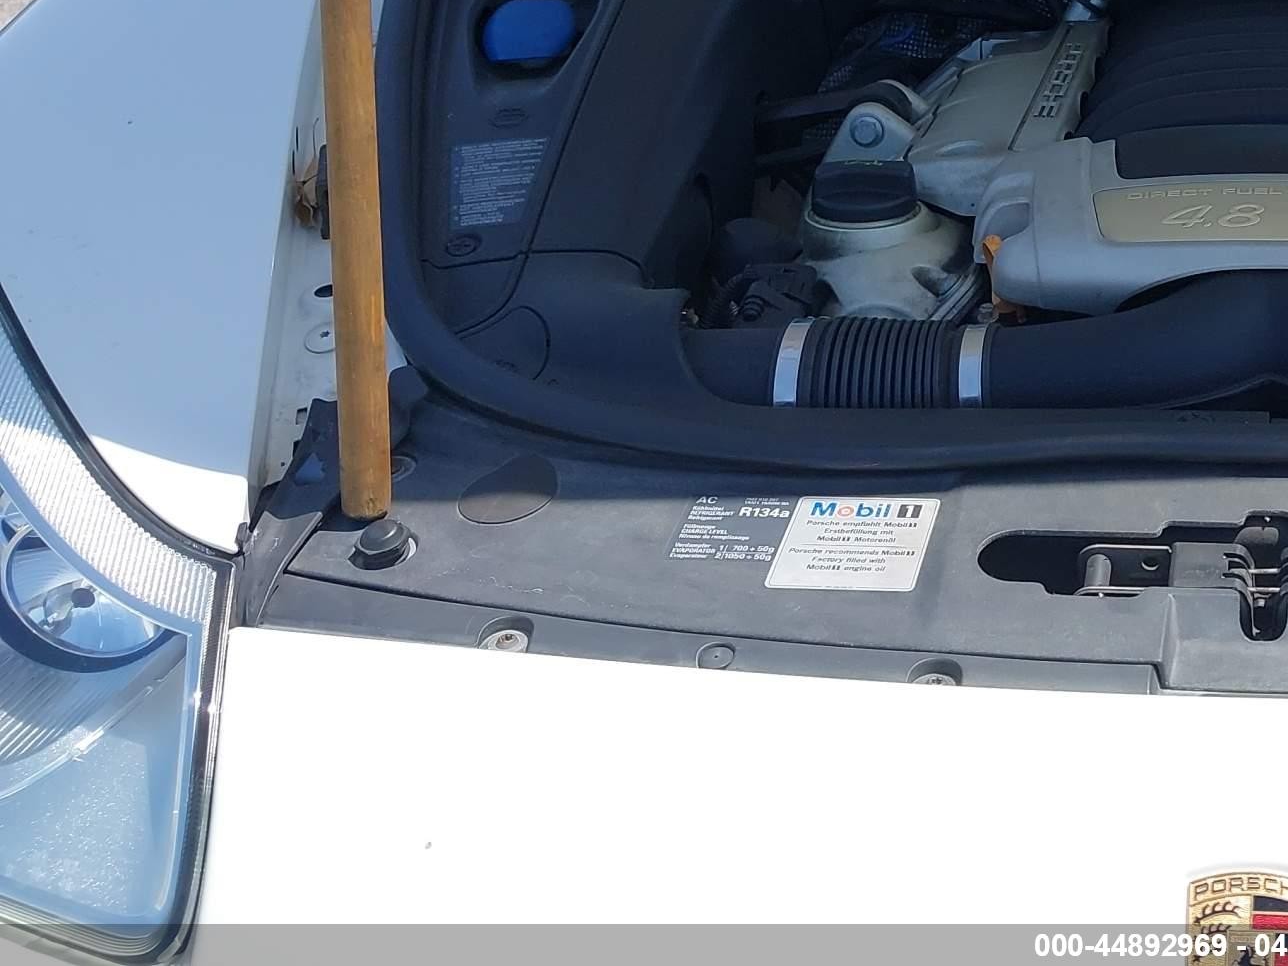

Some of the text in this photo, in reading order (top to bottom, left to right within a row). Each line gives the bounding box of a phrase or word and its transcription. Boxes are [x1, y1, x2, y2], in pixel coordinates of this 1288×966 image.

[1033, 43, 1081, 119] PORSCHE
[1127, 189, 1209, 201] DIRECT
[1221, 187, 1282, 196] FUEL
[1160, 203, 1266, 229] 4.8
[739, 506, 790, 518] R134a
[810, 502, 892, 518] Mobil
[842, 520, 882, 530] empfiehlt
[824, 528, 878, 536] Erstbefüllung
[812, 556, 843, 565] Factory
